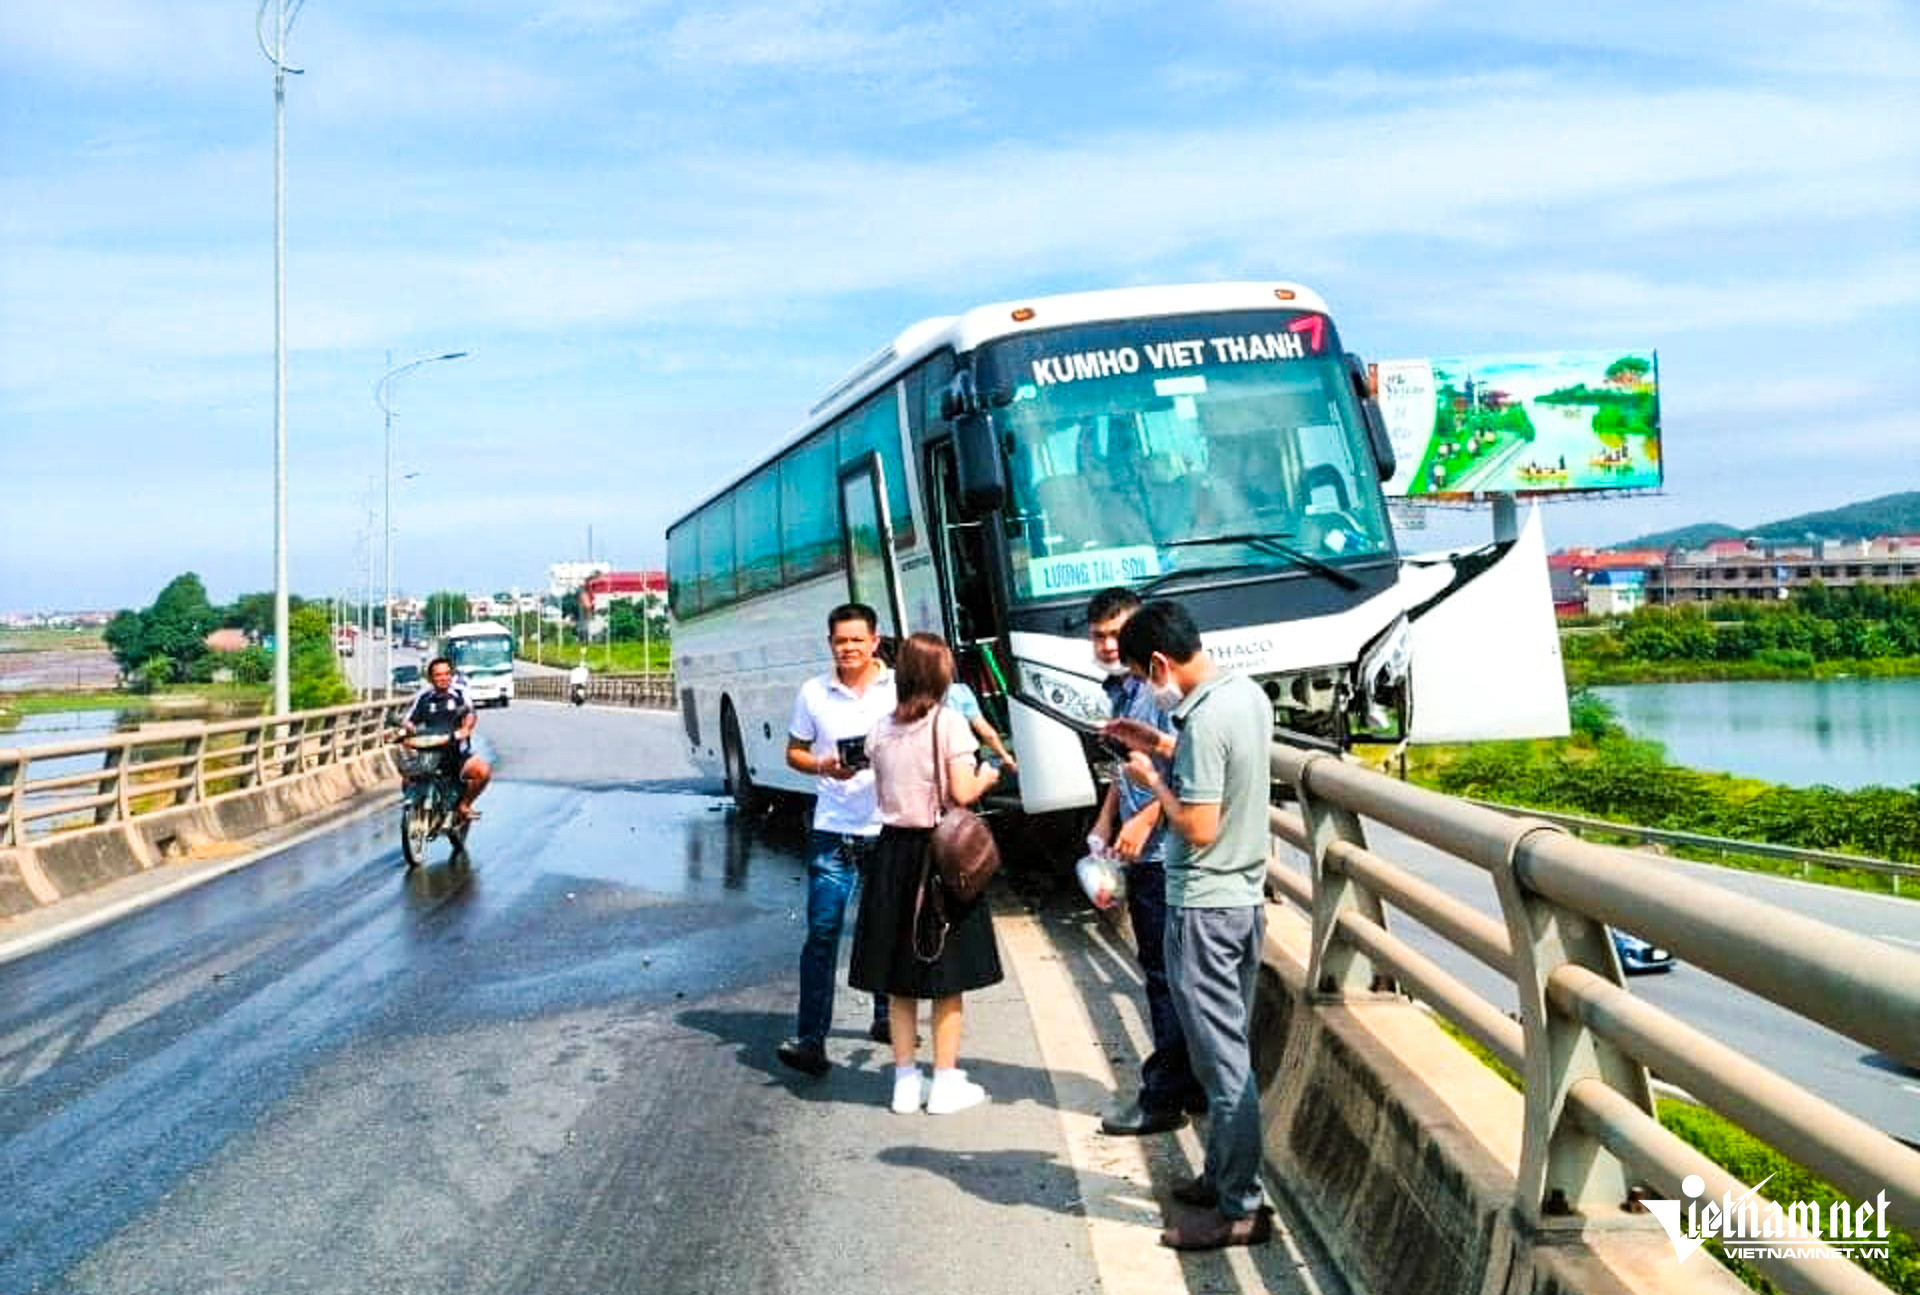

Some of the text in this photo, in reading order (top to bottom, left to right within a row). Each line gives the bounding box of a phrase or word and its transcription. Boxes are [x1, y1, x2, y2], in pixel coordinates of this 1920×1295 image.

[1031, 332, 1305, 386] KUMHO VIET THANH
